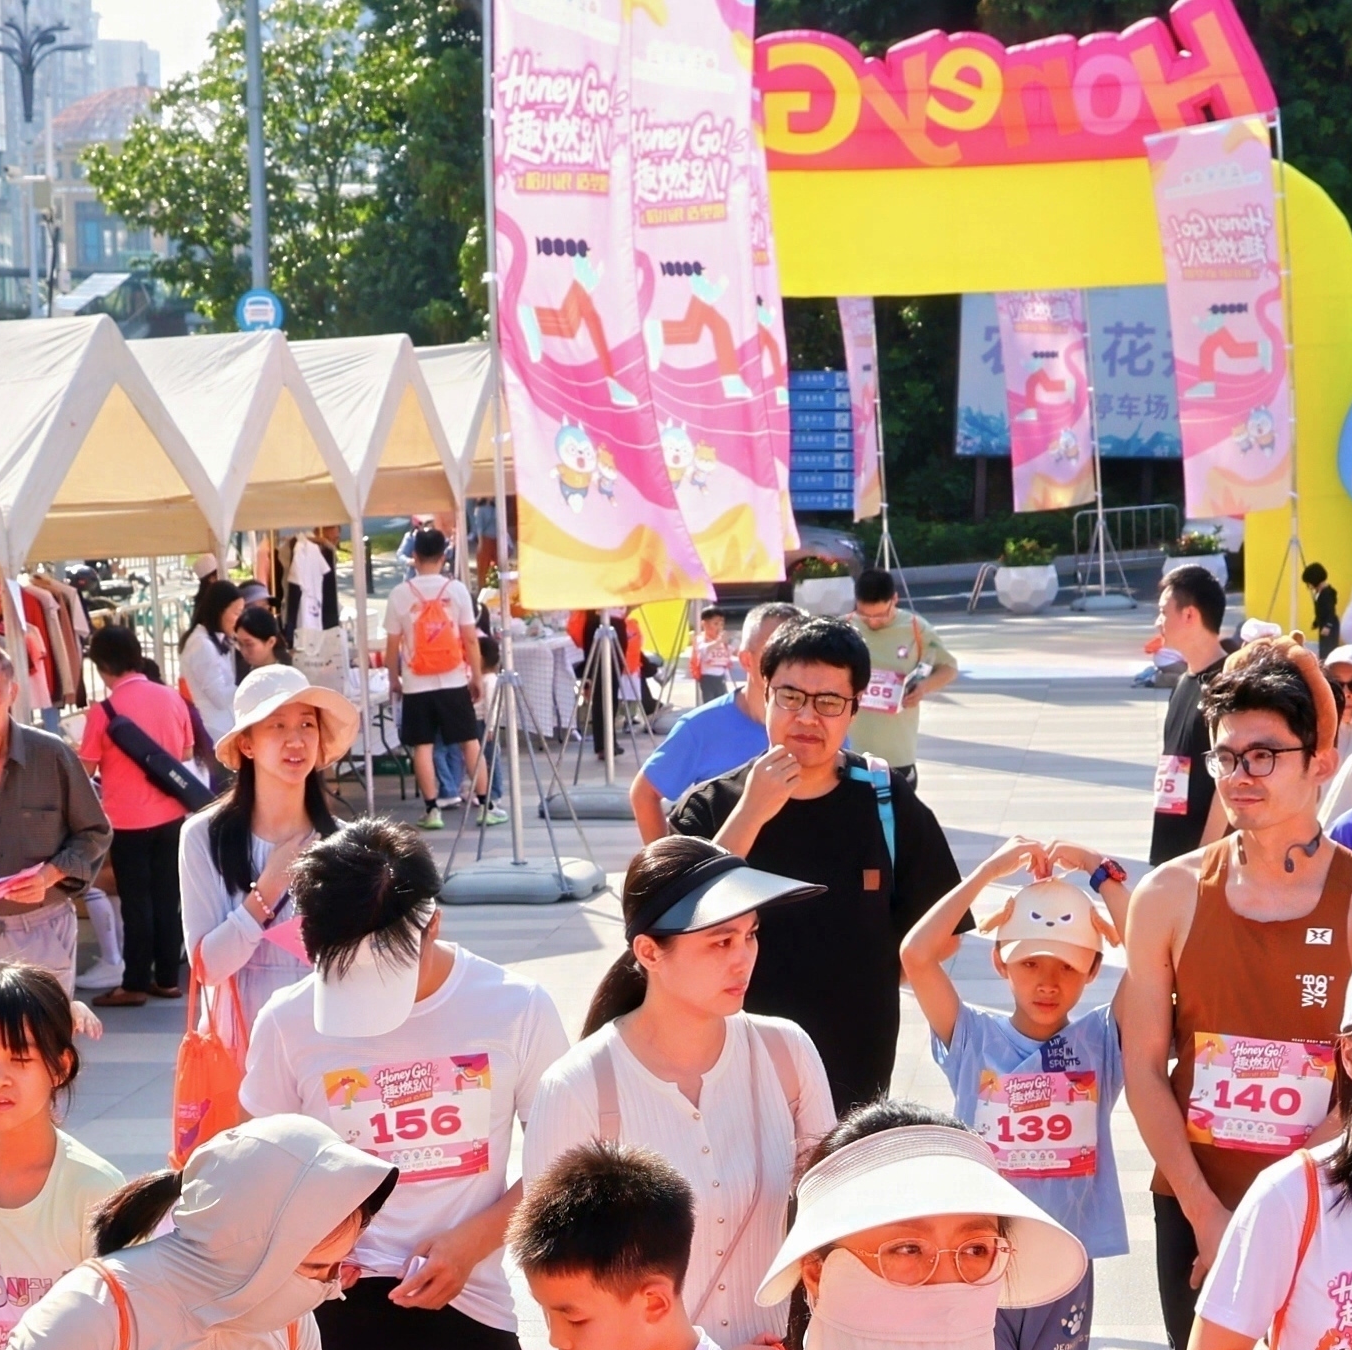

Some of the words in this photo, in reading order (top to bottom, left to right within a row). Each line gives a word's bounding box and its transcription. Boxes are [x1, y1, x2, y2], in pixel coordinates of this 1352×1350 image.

[499, 53, 582, 115] Honey
[631, 111, 691, 158] Honey
[690, 113, 733, 157] Go!
[1232, 1042, 1265, 1058] Honey
[1265, 1045, 1284, 1058] Go!
[375, 1068, 412, 1088] Honey
[411, 1063, 433, 1079] Go!
[1006, 1078, 1035, 1094] Honey
[1034, 1076, 1051, 1089] Go!
[1213, 1079, 1302, 1117] 140
[369, 1104, 462, 1144] 156
[997, 1114, 1073, 1142] 139
